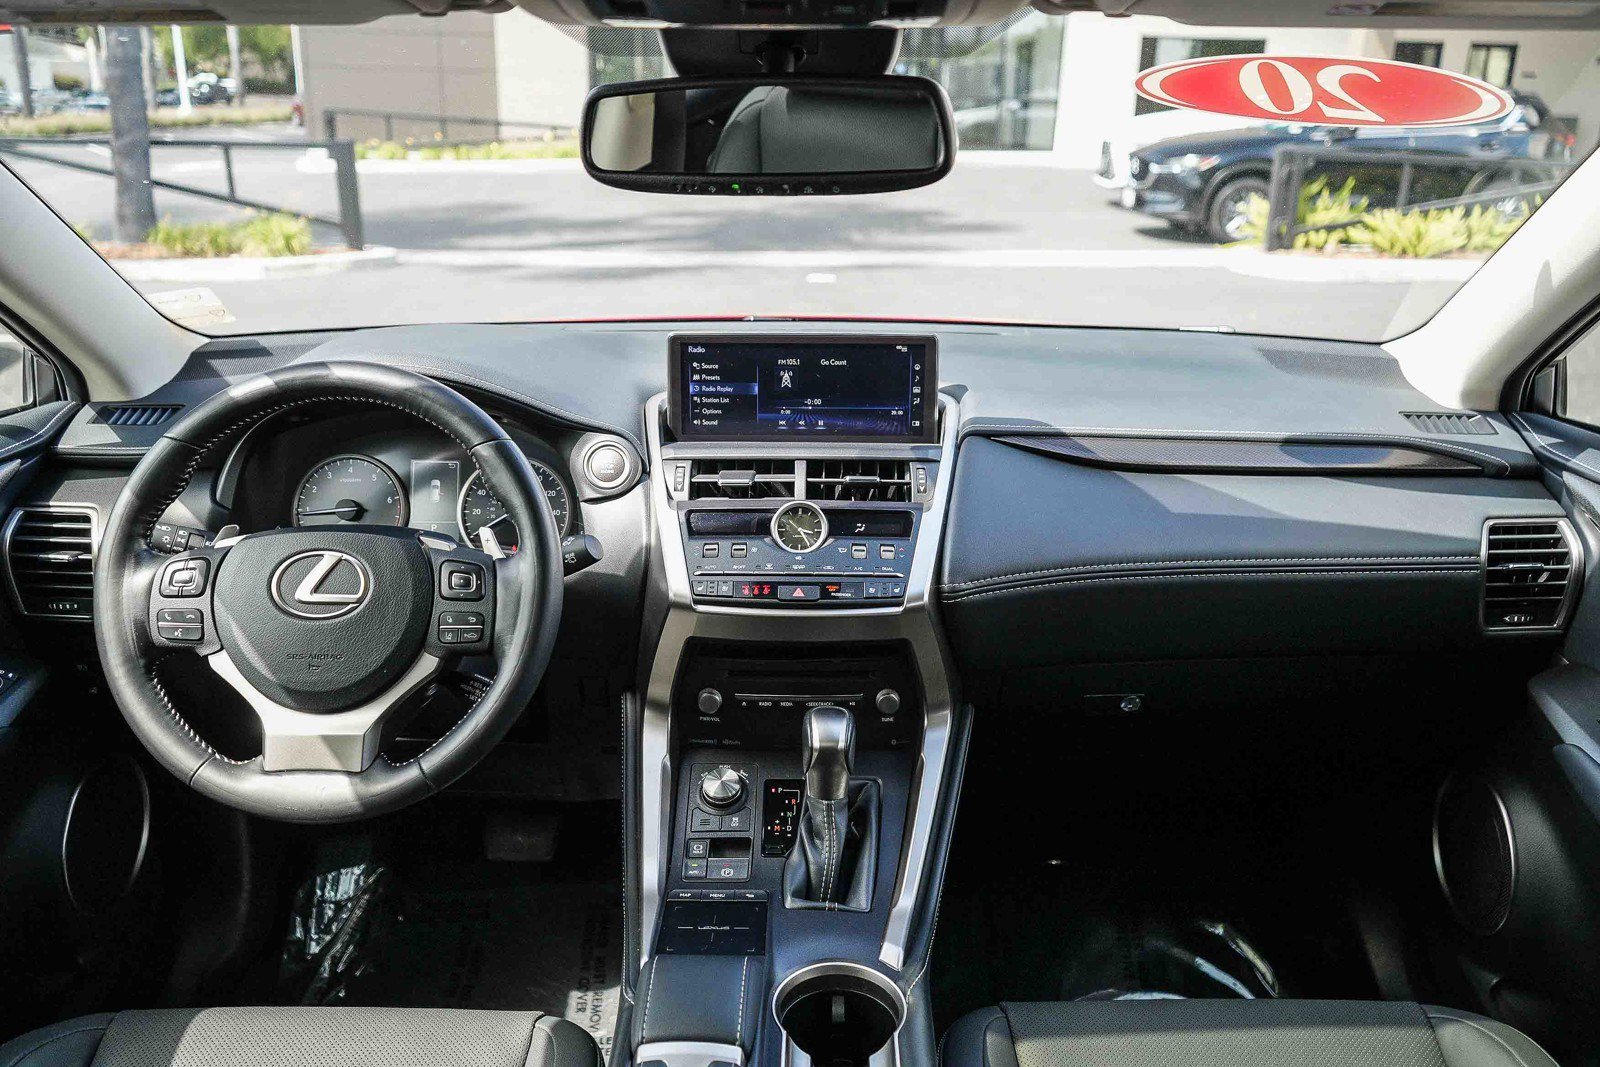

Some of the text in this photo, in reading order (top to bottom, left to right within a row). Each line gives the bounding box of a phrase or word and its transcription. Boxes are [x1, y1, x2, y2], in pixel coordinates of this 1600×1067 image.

[717, 385, 734, 393] Replay
[576, 977, 592, 1013] COVER
[588, 991, 604, 1033] REMOV
